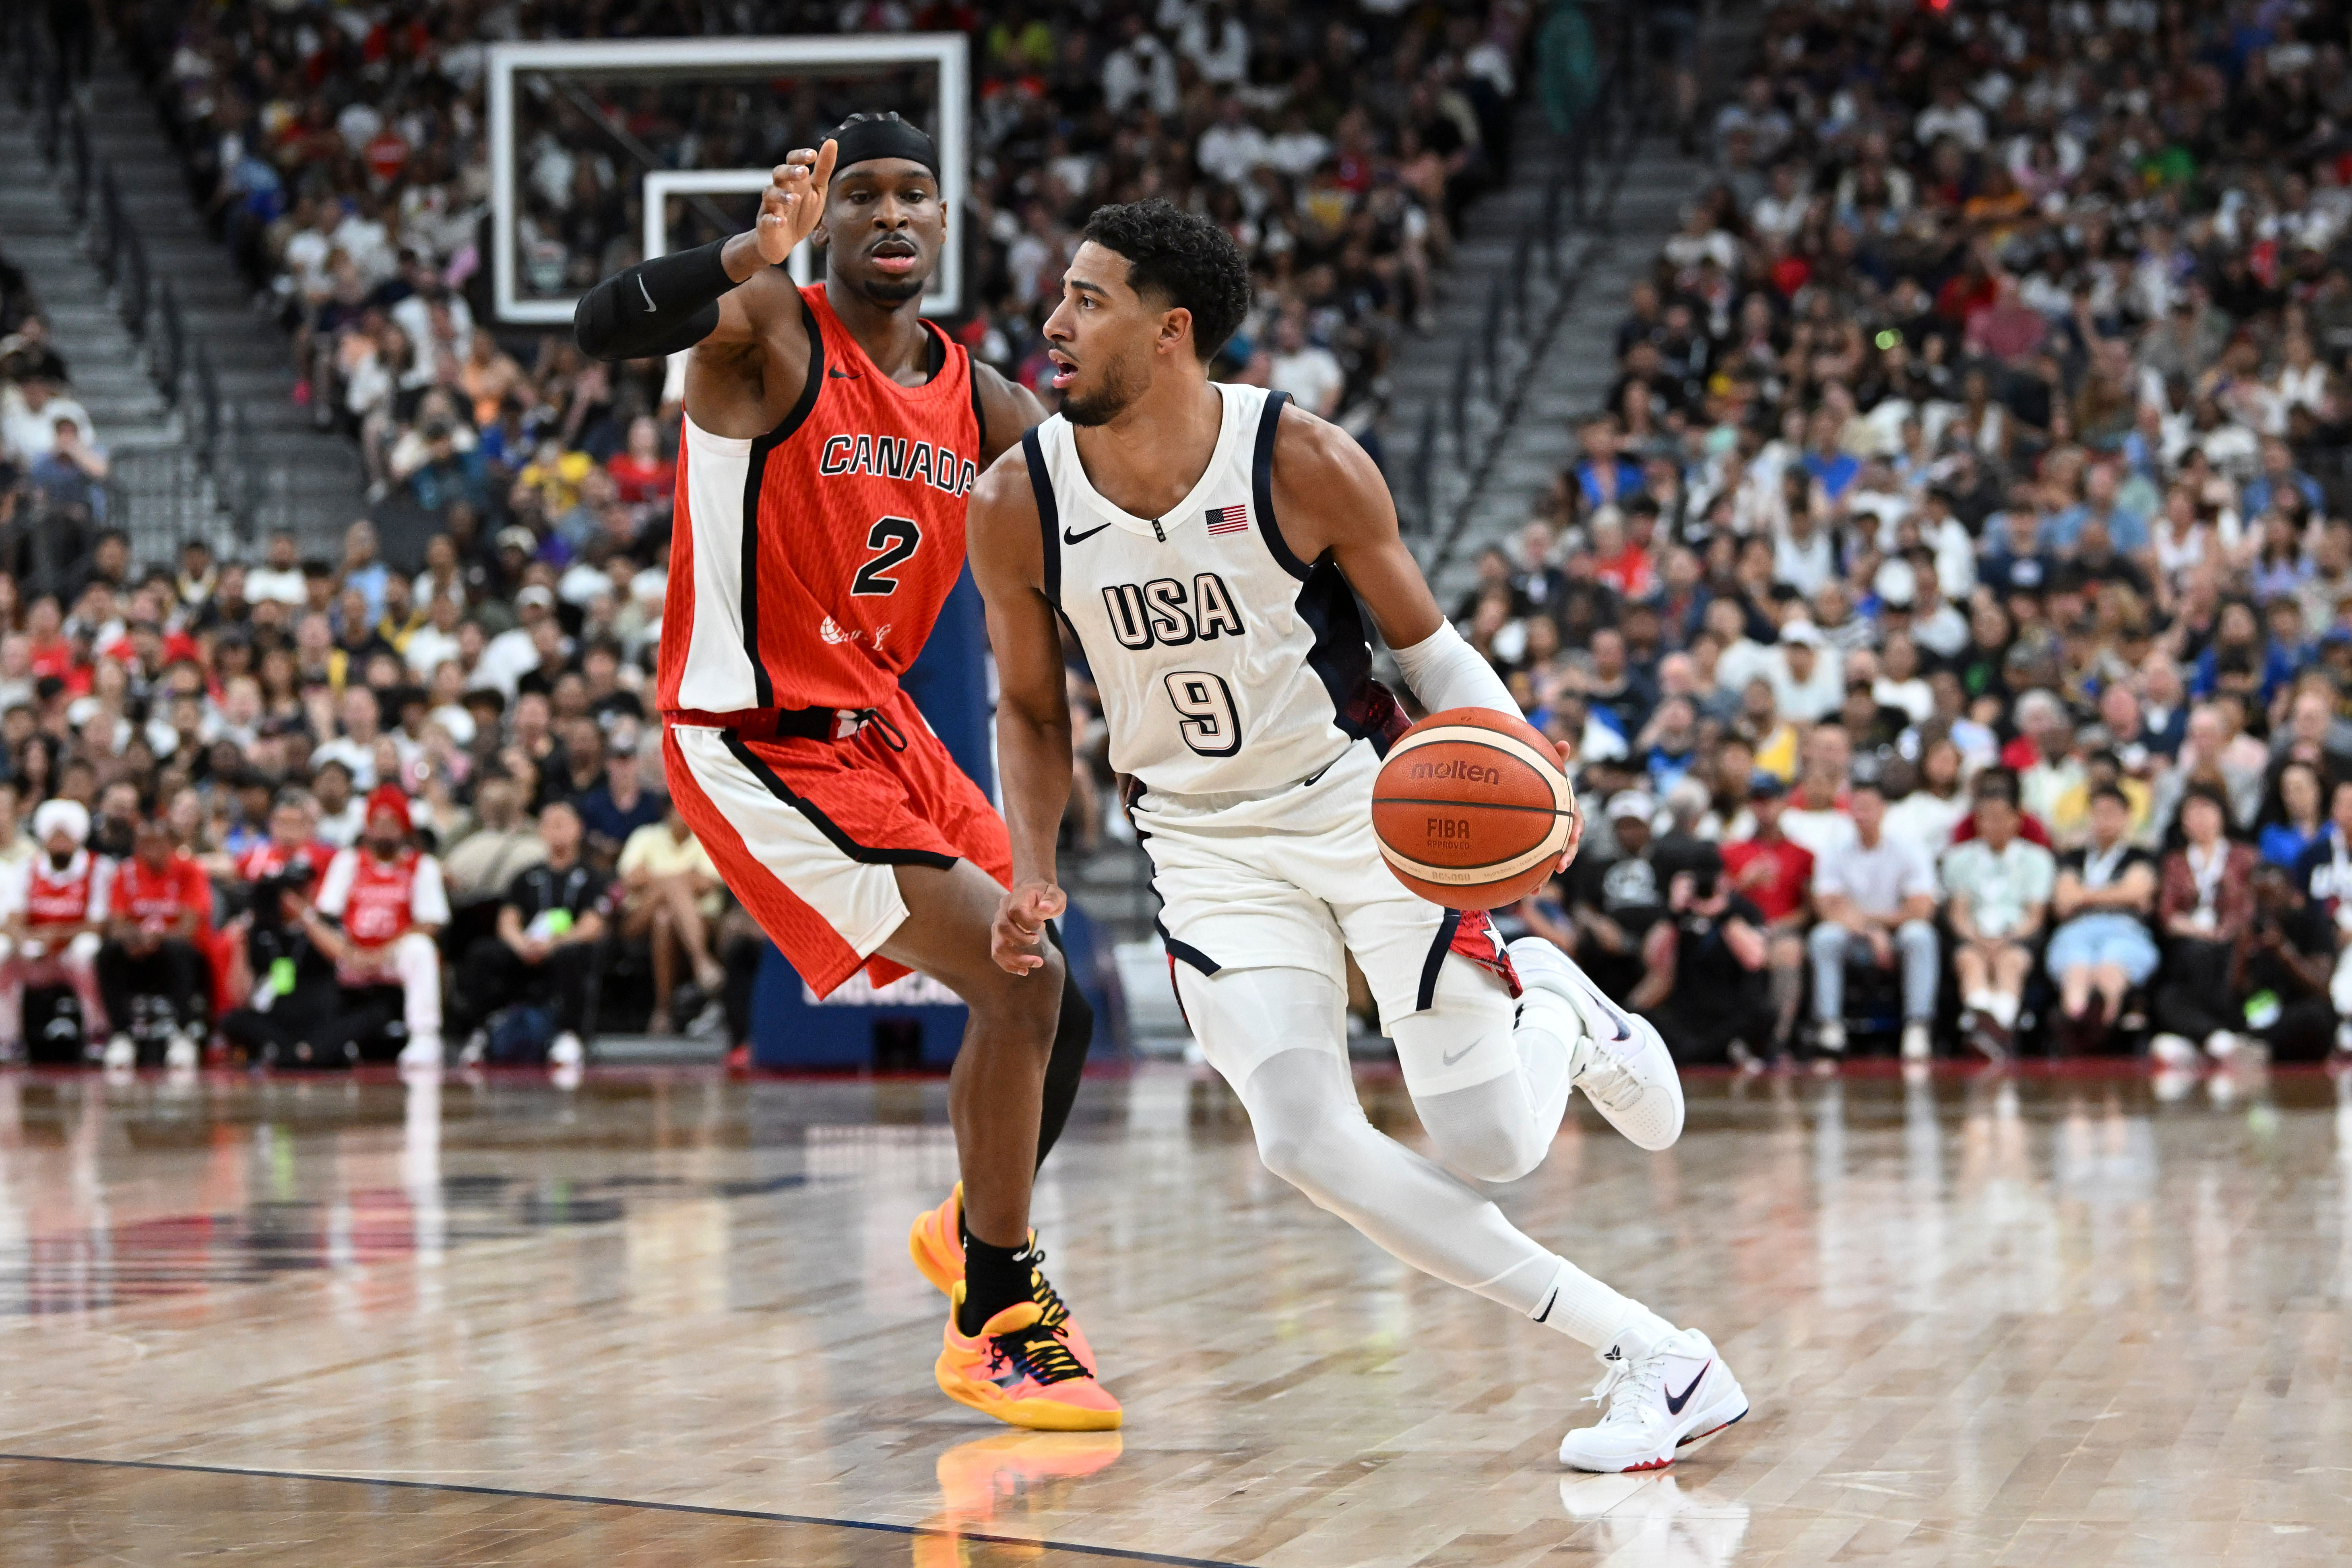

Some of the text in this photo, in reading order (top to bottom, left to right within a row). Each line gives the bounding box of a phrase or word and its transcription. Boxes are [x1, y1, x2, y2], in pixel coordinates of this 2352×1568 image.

[819, 434, 977, 497] CANADA
[850, 516, 922, 596] 2
[1102, 572, 1245, 650] USA
[1164, 671, 1242, 757] 9
[1411, 760, 1499, 785] molten
[1427, 818, 1469, 839] FIBA
[1427, 840, 1470, 850] APPROVED
